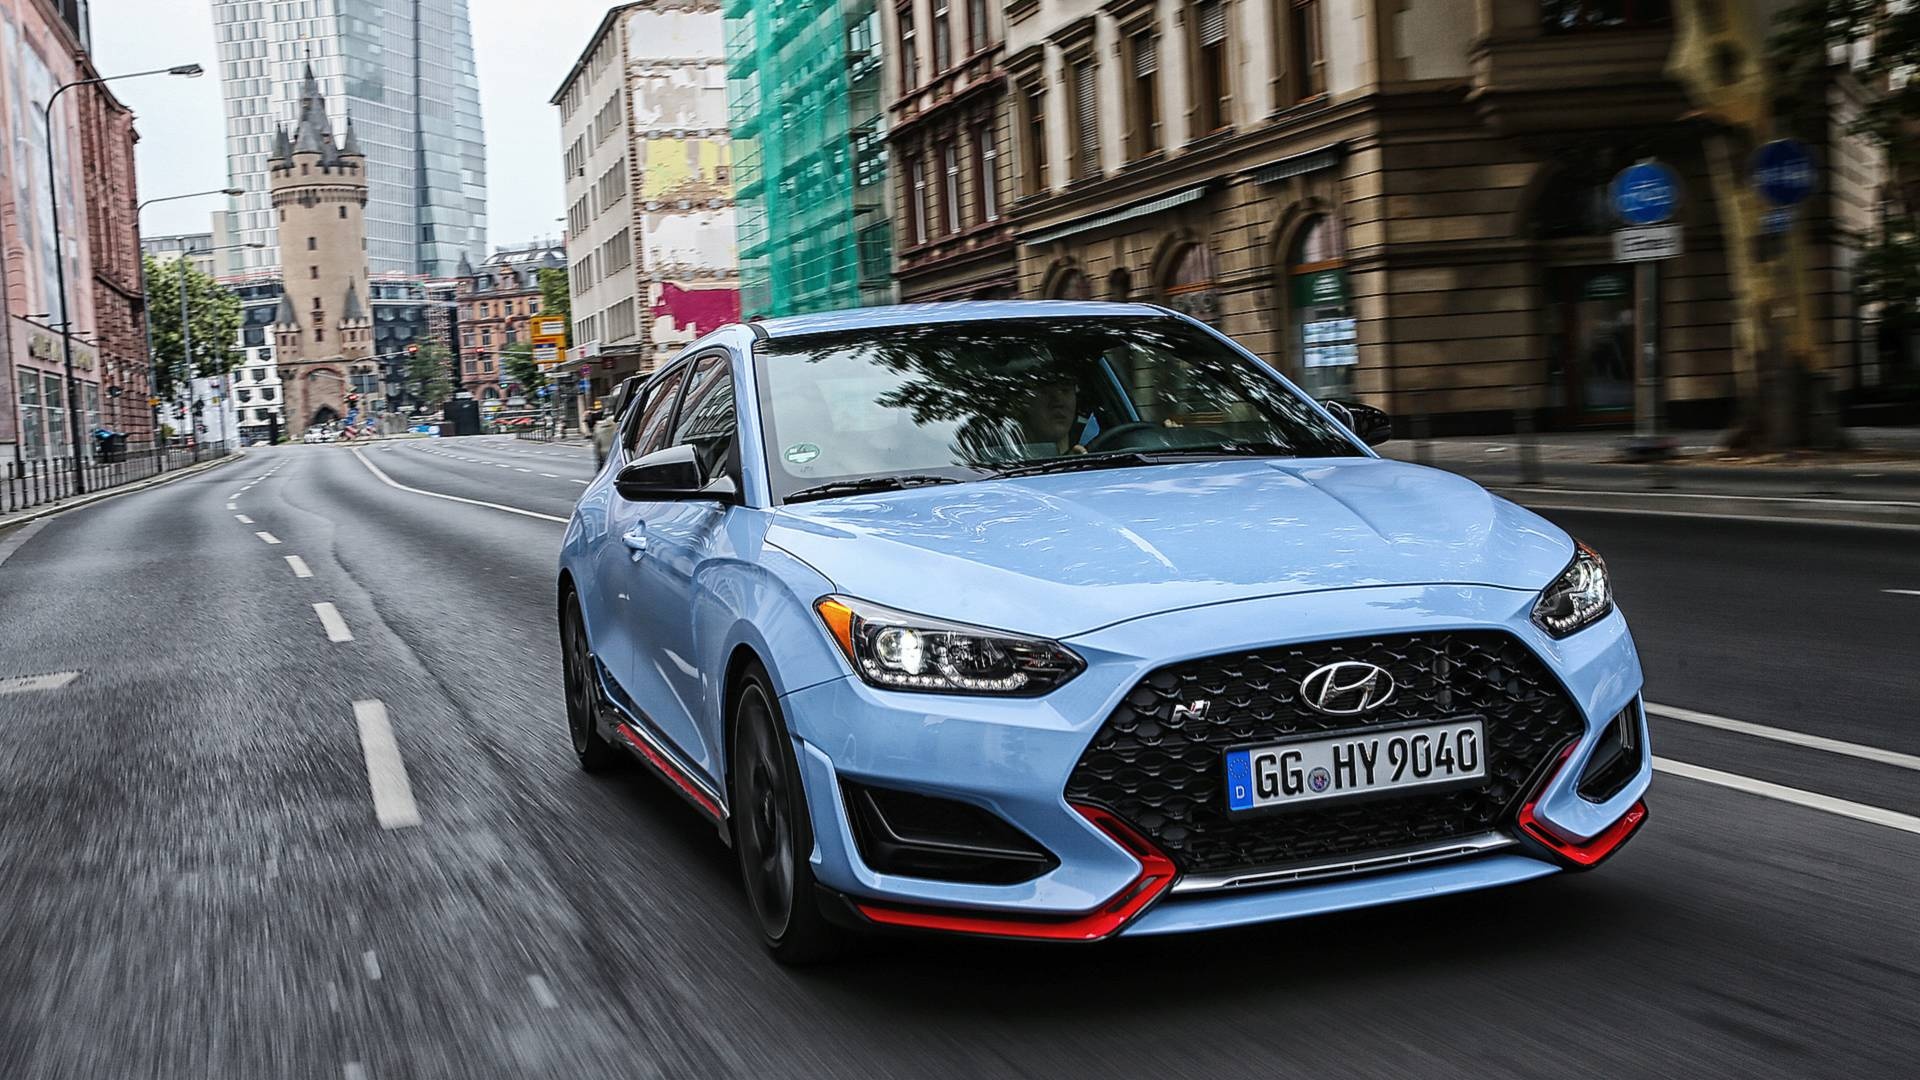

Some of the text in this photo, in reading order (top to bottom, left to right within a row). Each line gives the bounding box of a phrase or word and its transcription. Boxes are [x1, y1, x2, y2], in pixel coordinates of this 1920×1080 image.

[1254, 728, 1478, 799] GG HY 9040
[1235, 785, 1246, 799] D
